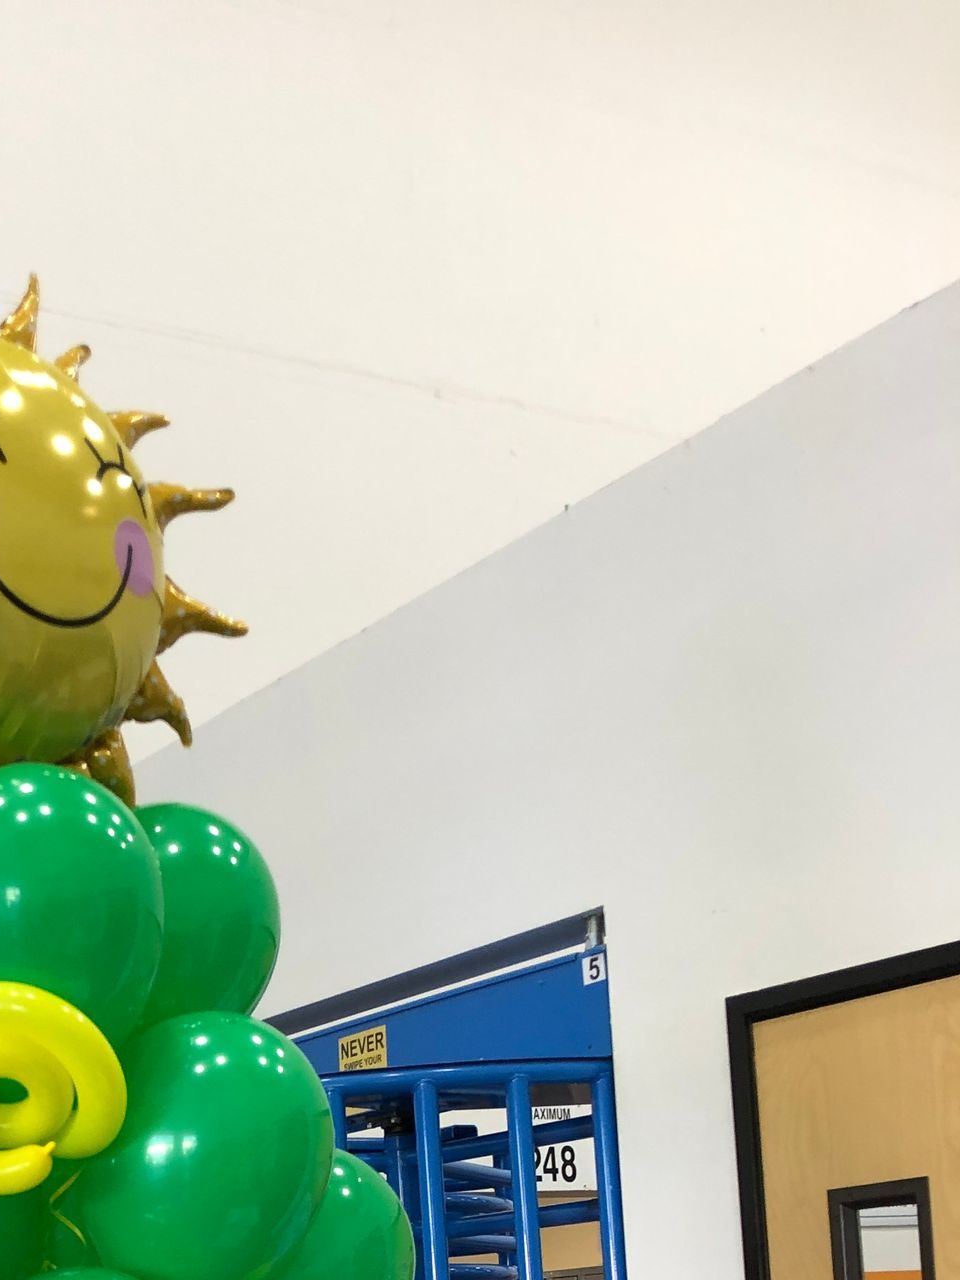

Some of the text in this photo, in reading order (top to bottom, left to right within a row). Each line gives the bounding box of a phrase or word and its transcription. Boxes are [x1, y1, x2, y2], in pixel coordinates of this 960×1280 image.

[589, 956, 600, 980] 5
[341, 1032, 384, 1060] NEVER
[344, 1054, 382, 1070] SWIPE YOUR
[533, 1107, 571, 1120] AXIMUM
